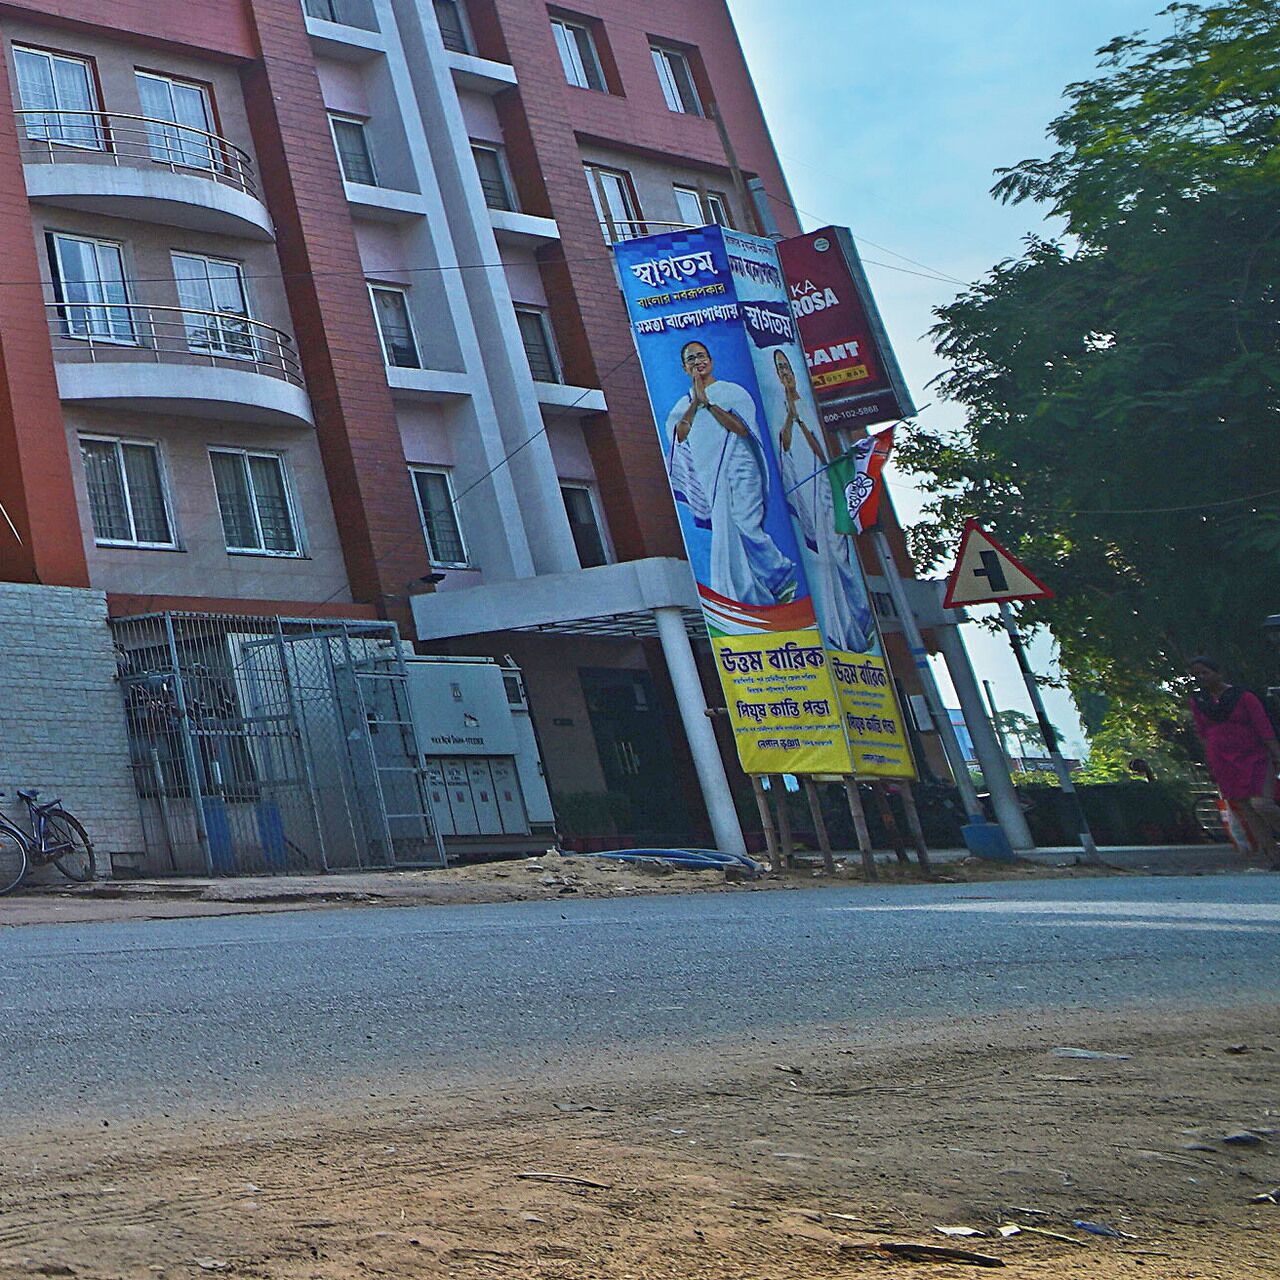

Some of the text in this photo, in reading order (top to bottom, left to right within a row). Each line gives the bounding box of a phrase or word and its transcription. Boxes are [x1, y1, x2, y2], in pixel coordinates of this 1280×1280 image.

[630, 251, 718, 287] স্বাগতম
[637, 292, 671, 308] বাংলার
[791, 287, 840, 319] ROSA
[635, 317, 665, 334] মমতা
[744, 305, 794, 339] স্বাগতম
[720, 642, 825, 673] উত্তম বারিক
[832, 657, 887, 687] উত্তম বারিক
[767, 697, 800, 717] কান্তি
